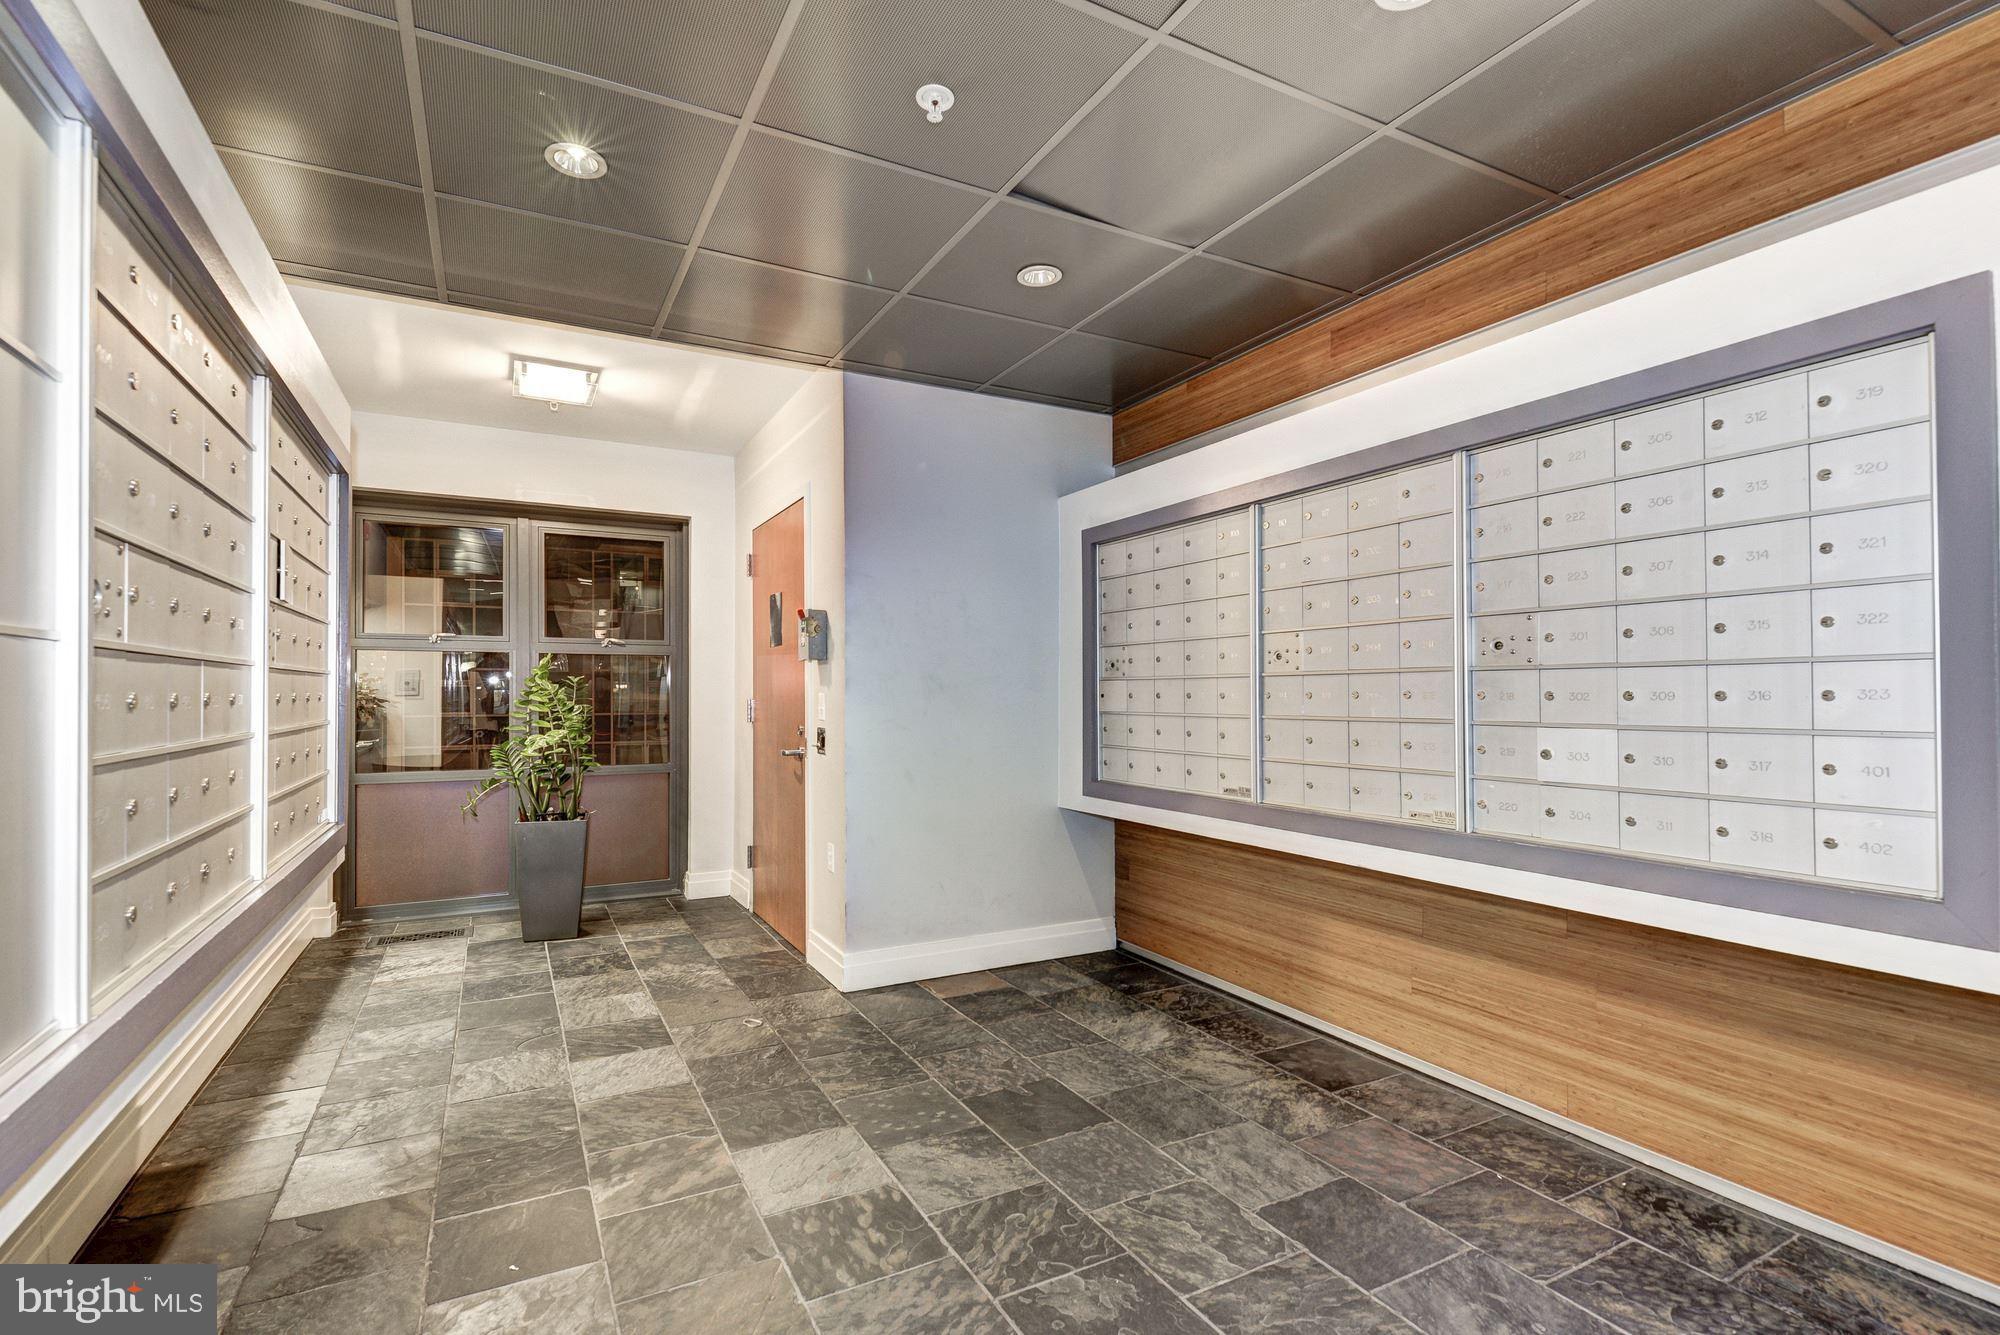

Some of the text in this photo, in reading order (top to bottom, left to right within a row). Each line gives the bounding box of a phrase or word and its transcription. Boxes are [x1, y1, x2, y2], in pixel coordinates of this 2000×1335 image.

[1855, 385, 1885, 401] 319
[1743, 409, 1768, 425] 312
[1647, 430, 1673, 446] 305
[1567, 449, 1587, 463] 221
[1854, 461, 1889, 476] 320
[1744, 479, 1769, 494] 313
[1647, 495, 1674, 509] 306
[1564, 510, 1586, 523] 222
[1857, 535, 1887, 550] 321
[1745, 549, 1770, 562] 314
[1648, 559, 1674, 573] 307
[1567, 570, 1589, 583] 223
[1746, 619, 1771, 632] 315
[1856, 612, 1889, 626] 322
[1568, 631, 1589, 642] 301
[1648, 625, 1675, 637] 308
[1568, 691, 1591, 702] 302
[1649, 690, 1676, 702] 309
[1747, 689, 1772, 702] 316
[1856, 688, 1891, 701] 323
[1566, 751, 1591, 762] 303
[1652, 755, 1675, 767] 310
[1748, 760, 1773, 772] 317
[1860, 765, 1891, 779] 401
[1497, 801, 1519, 813] 220
[1568, 809, 1592, 822] 304
[1655, 819, 1673, 832] 311
[1749, 830, 1774, 844] 318
[1858, 841, 1894, 857] 402
